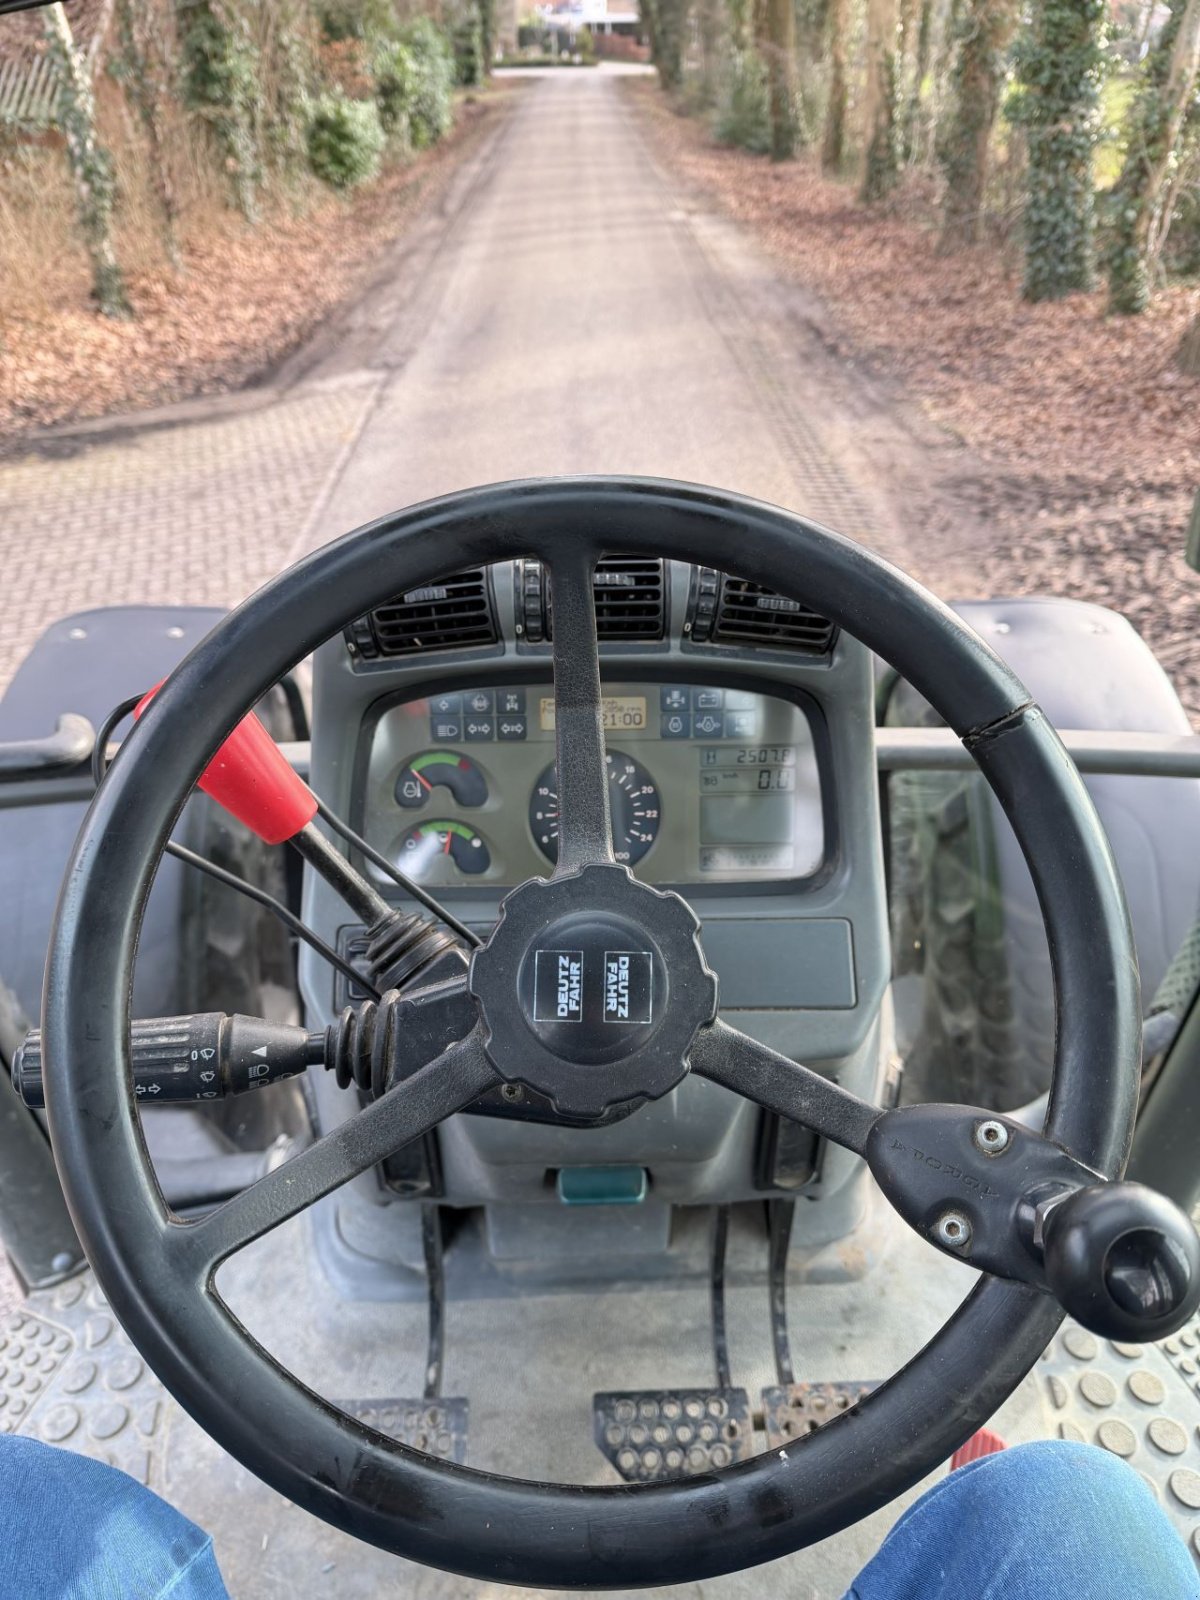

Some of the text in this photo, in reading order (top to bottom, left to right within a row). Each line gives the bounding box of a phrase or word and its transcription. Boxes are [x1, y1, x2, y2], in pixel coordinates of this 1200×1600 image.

[538, 787, 549, 796] 10
[641, 786, 654, 794] 20
[645, 810, 658, 818] 22
[640, 833, 653, 842] 24
[557, 955, 570, 1017] DEUTZ
[569, 961, 581, 1012] FAHR
[606, 962, 618, 1012] FAHR
[617, 956, 630, 1018] DEUTZ
